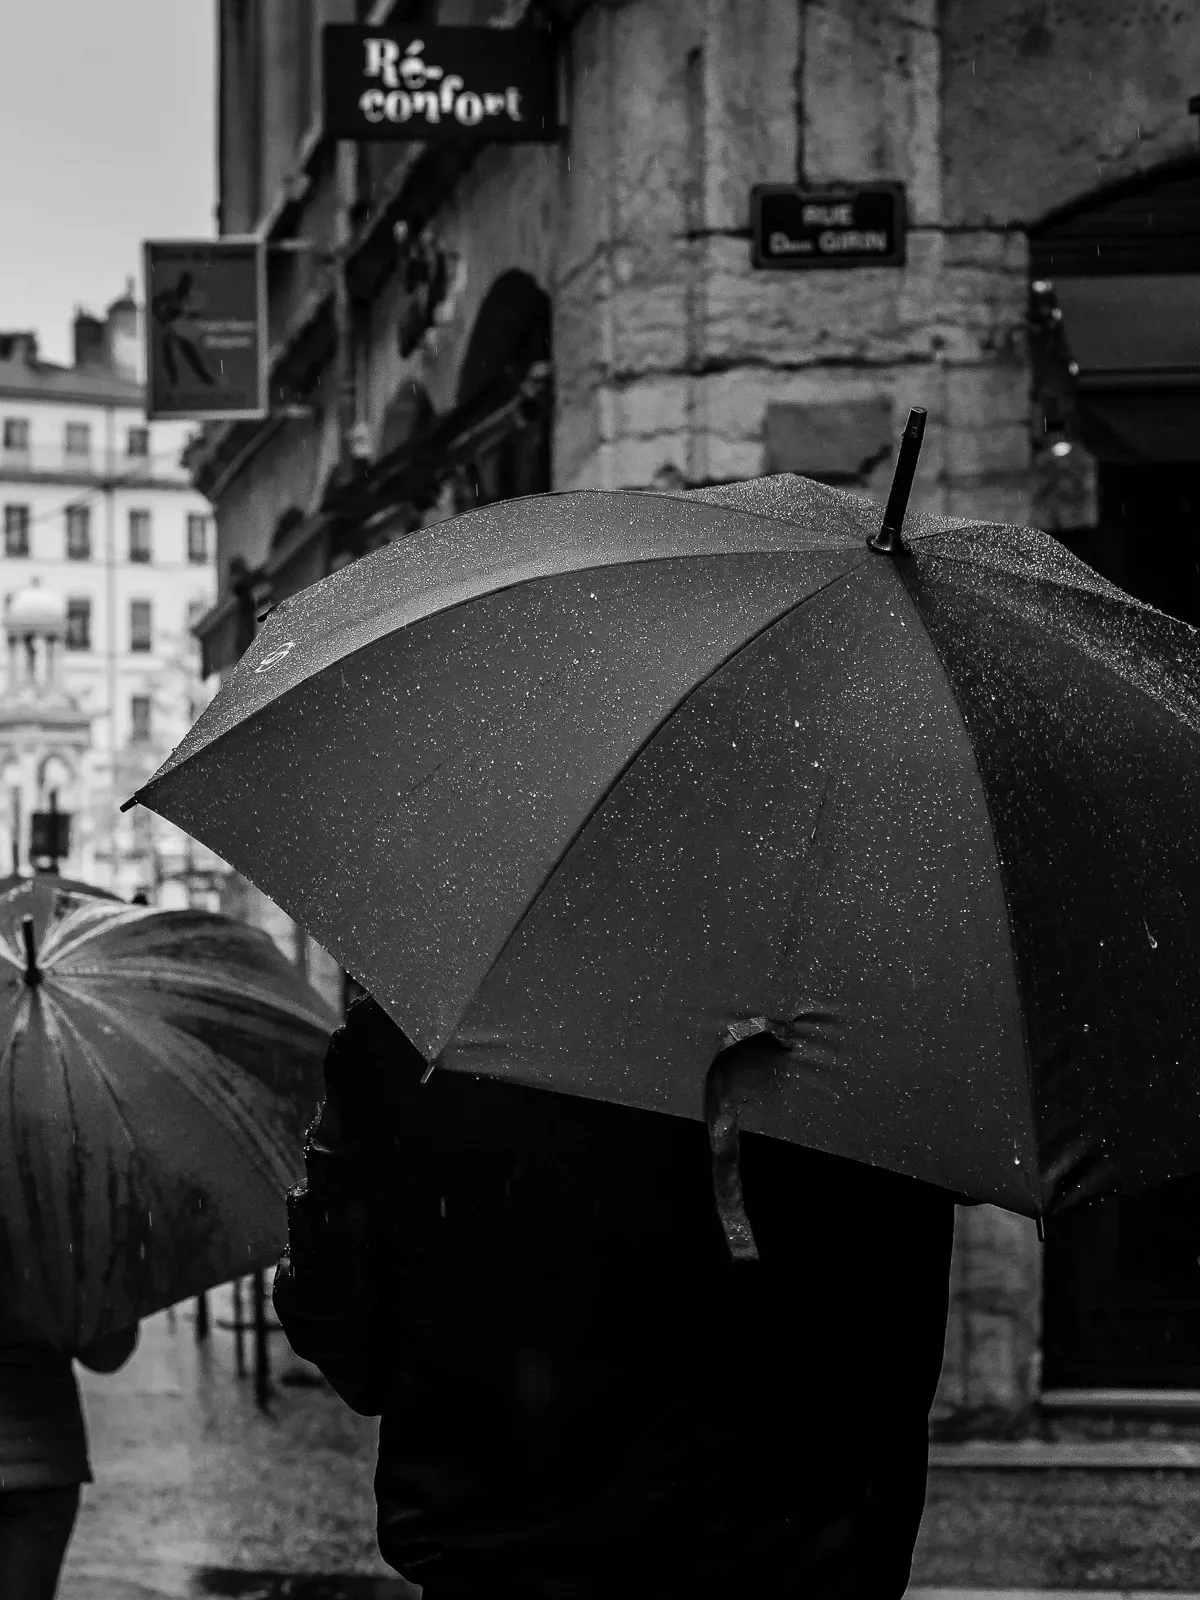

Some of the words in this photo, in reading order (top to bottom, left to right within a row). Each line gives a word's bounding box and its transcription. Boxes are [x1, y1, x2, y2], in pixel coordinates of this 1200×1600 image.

[363, 38, 443, 88] Ré-
[359, 74, 522, 126] confort
[802, 204, 854, 227] RUE
